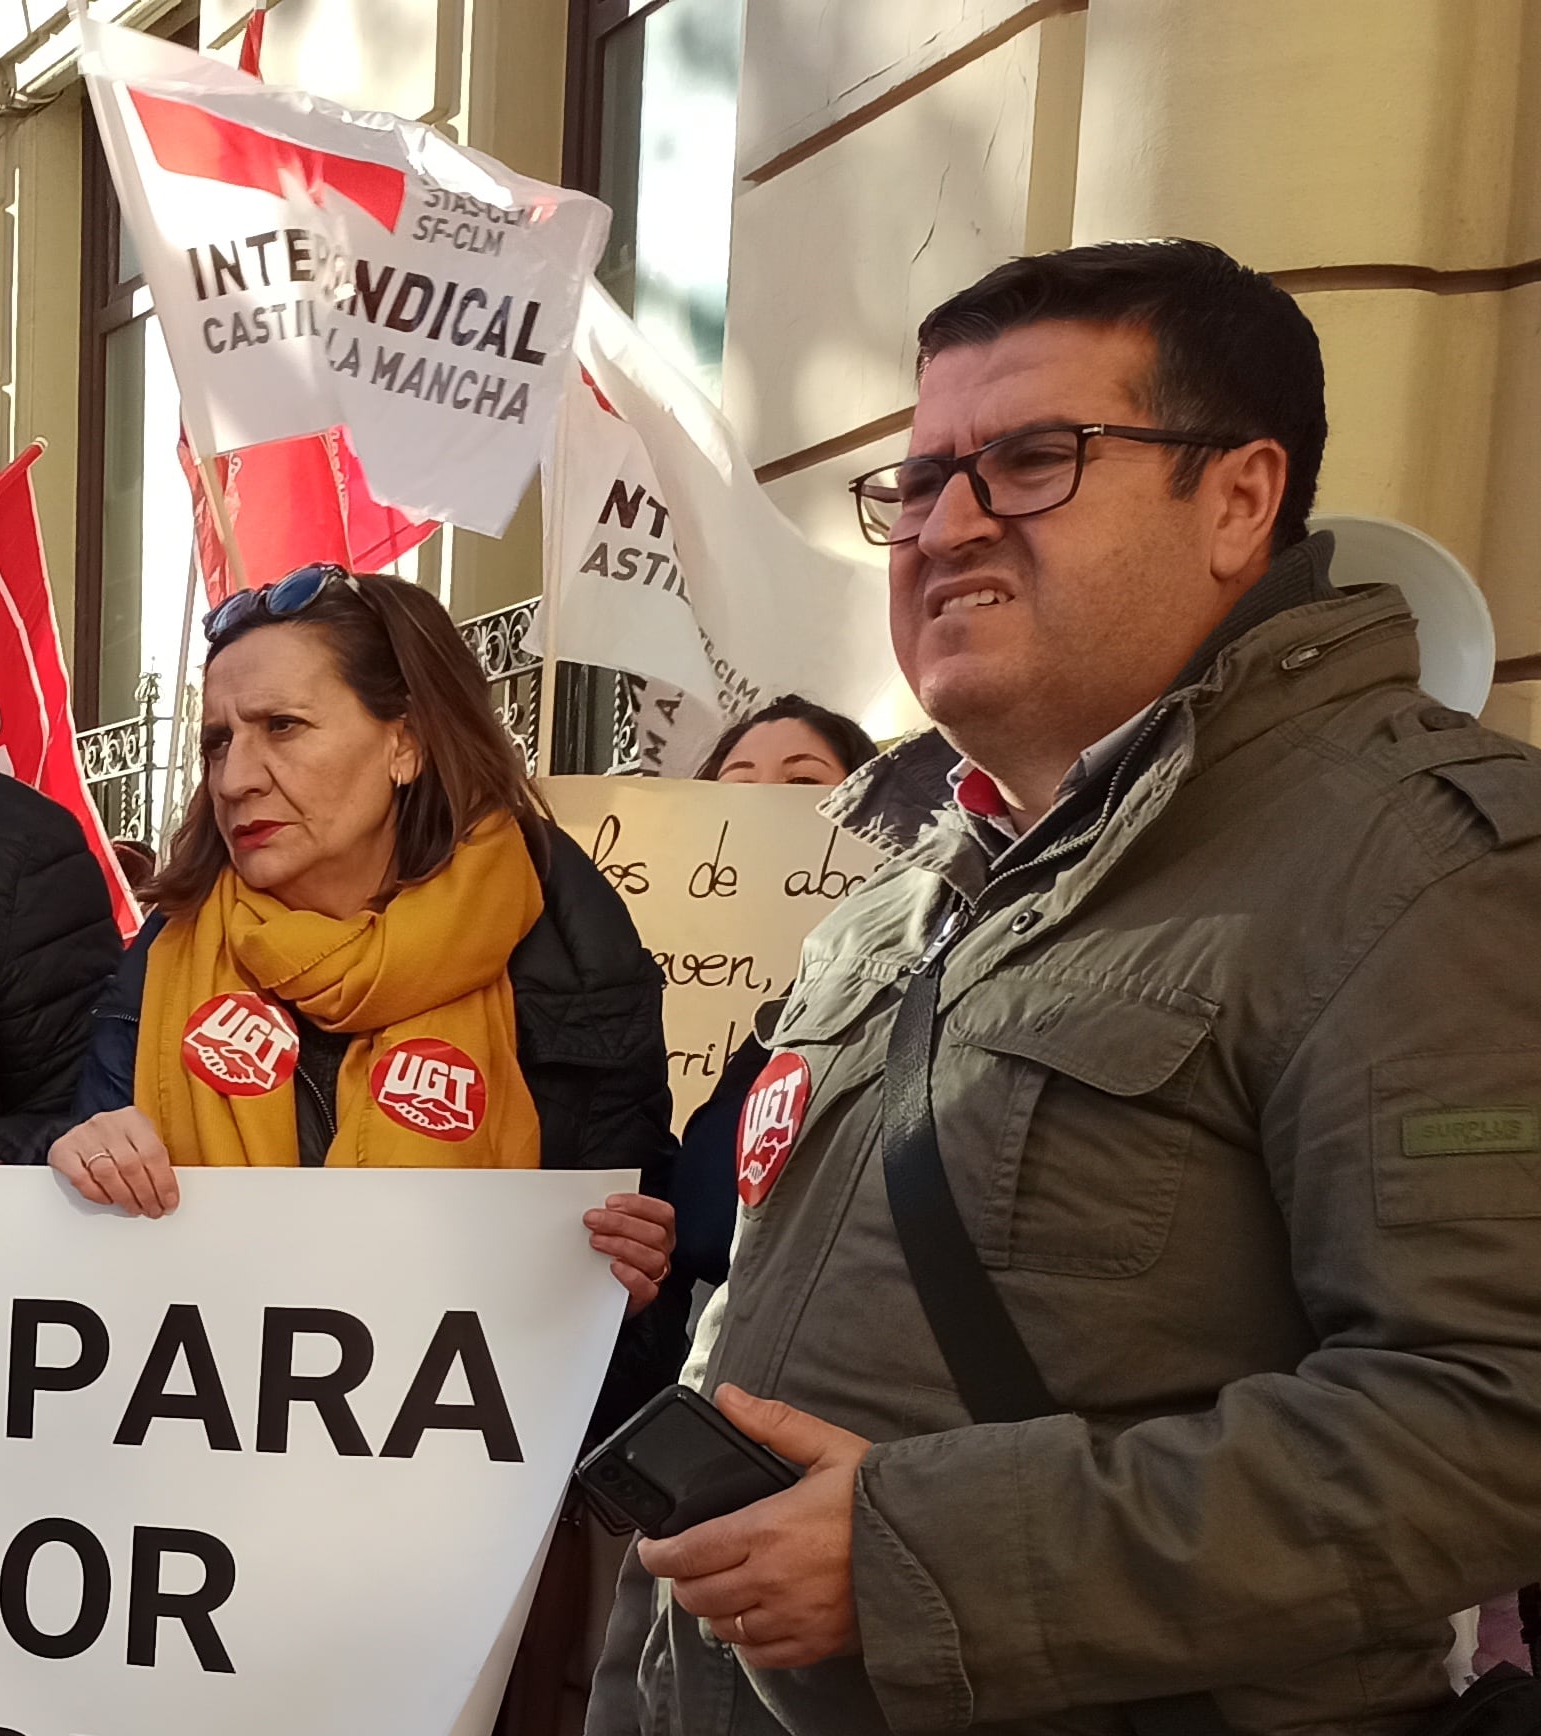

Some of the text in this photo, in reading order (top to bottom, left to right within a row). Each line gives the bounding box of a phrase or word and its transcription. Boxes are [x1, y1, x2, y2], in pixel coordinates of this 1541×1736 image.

[412, 215, 505, 257] SF-CLM
[371, 346, 530, 424] MANCHA
[688, 820, 738, 899] de
[201, 998, 295, 1072] UGT
[383, 1051, 476, 1113] UGT
[743, 1067, 803, 1152] UGT
[5, 1297, 524, 1464] PARA
